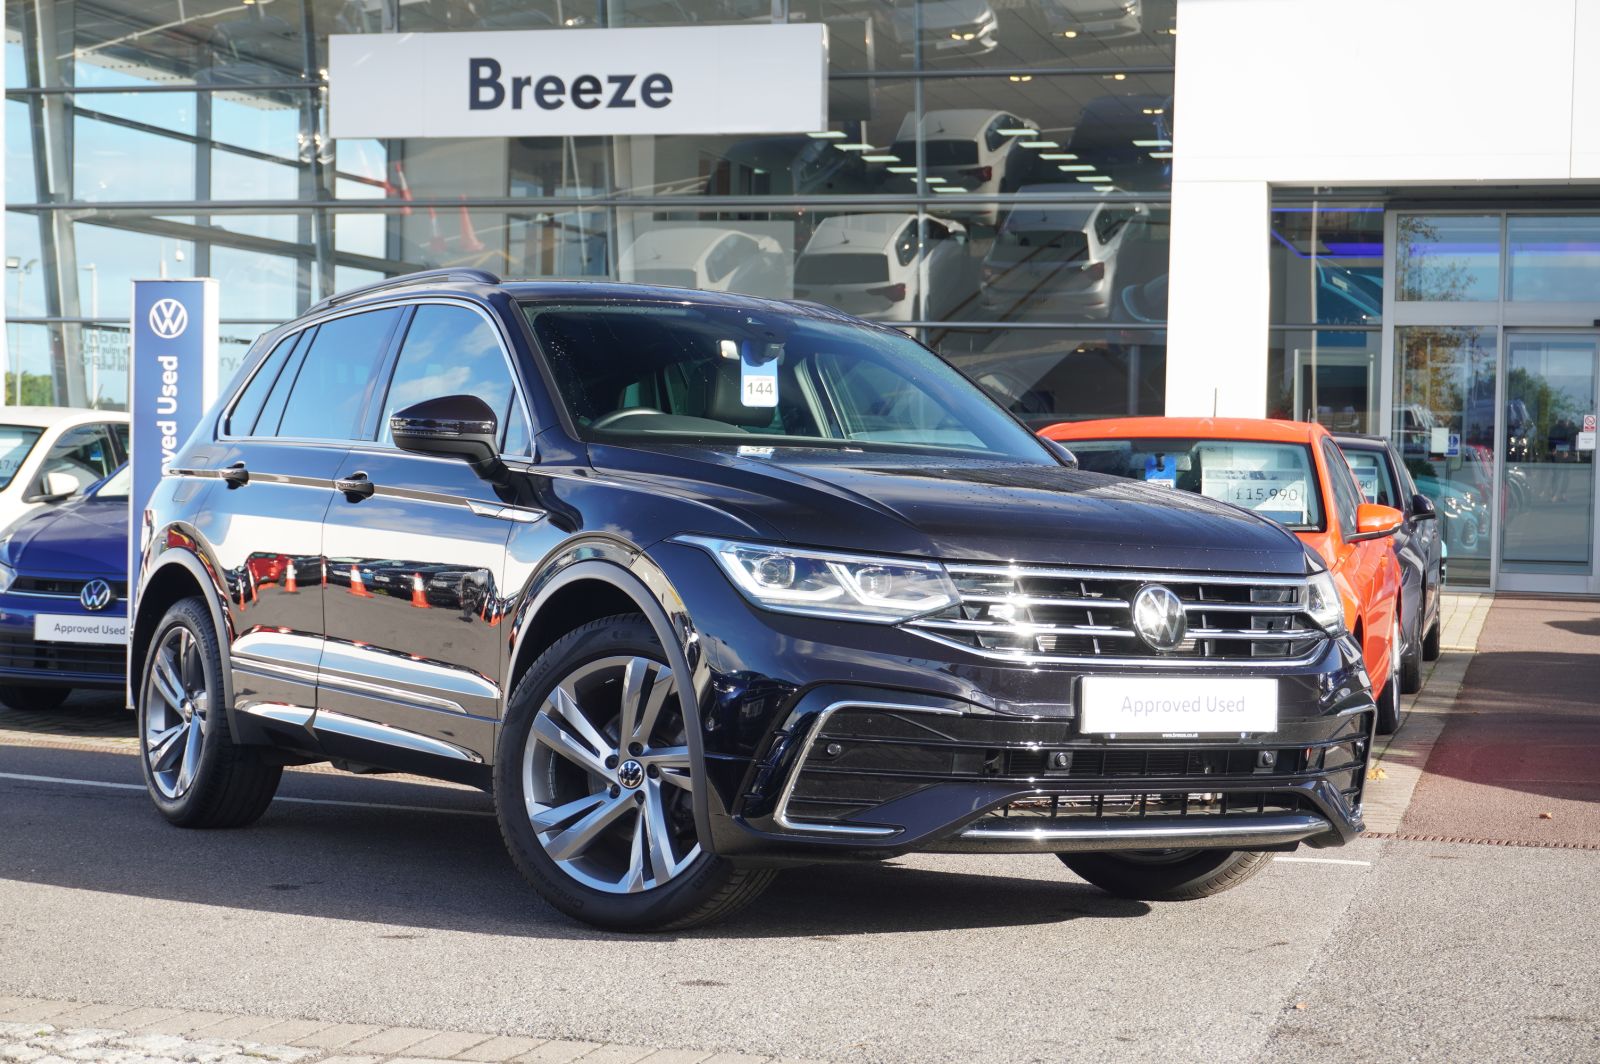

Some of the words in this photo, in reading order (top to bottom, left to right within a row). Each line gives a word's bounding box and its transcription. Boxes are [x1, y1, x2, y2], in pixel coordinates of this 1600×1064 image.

[469, 57, 673, 110] Breeze
[157, 356, 178, 414] Used
[747, 382, 773, 395] 144
[1236, 488, 1298, 502] £15,990
[54, 623, 99, 634] Approved
[101, 625, 126, 635] Used
[1121, 695, 1200, 716] Approved
[1206, 695, 1245, 712] Used
